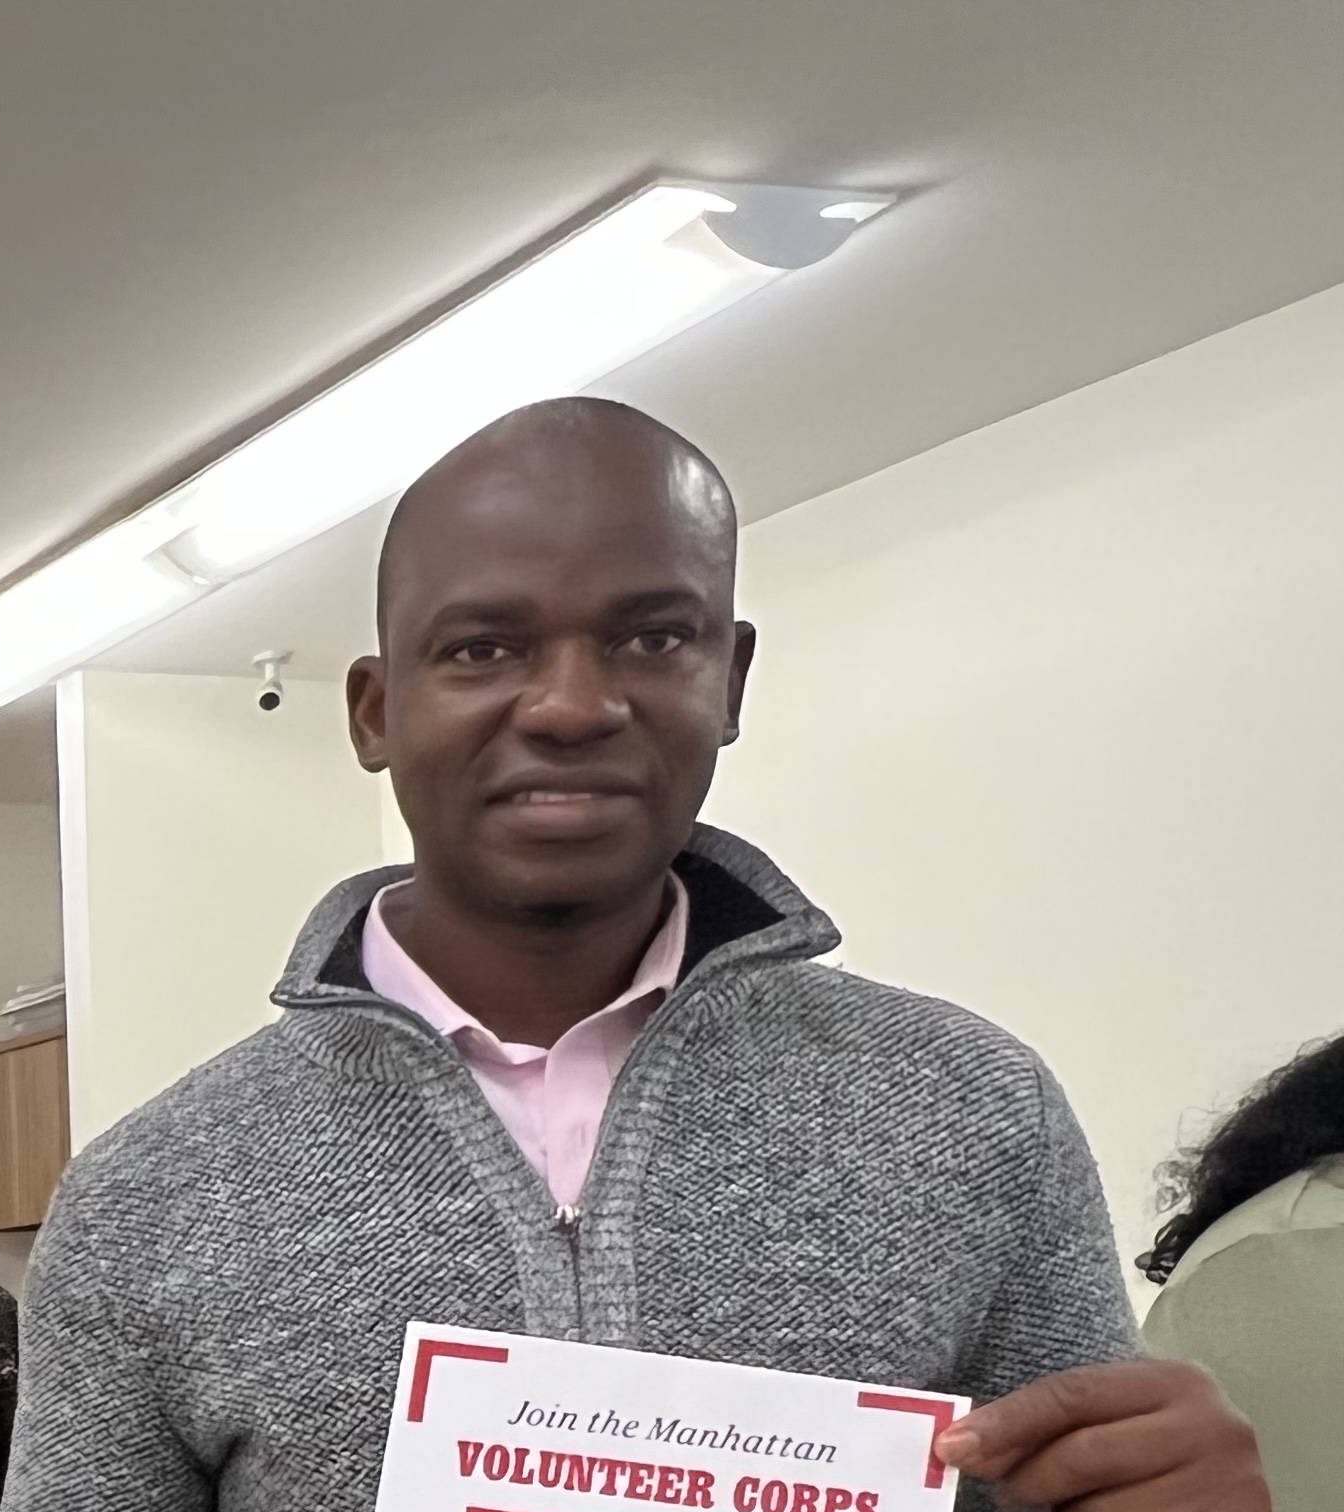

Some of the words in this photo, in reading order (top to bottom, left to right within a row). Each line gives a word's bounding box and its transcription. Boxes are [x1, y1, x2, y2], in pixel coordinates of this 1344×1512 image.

[507, 1400, 578, 1431] Join
[587, 1409, 640, 1439] the
[644, 1417, 838, 1463] Manhattan
[457, 1440, 716, 1509] VOLUNTEER
